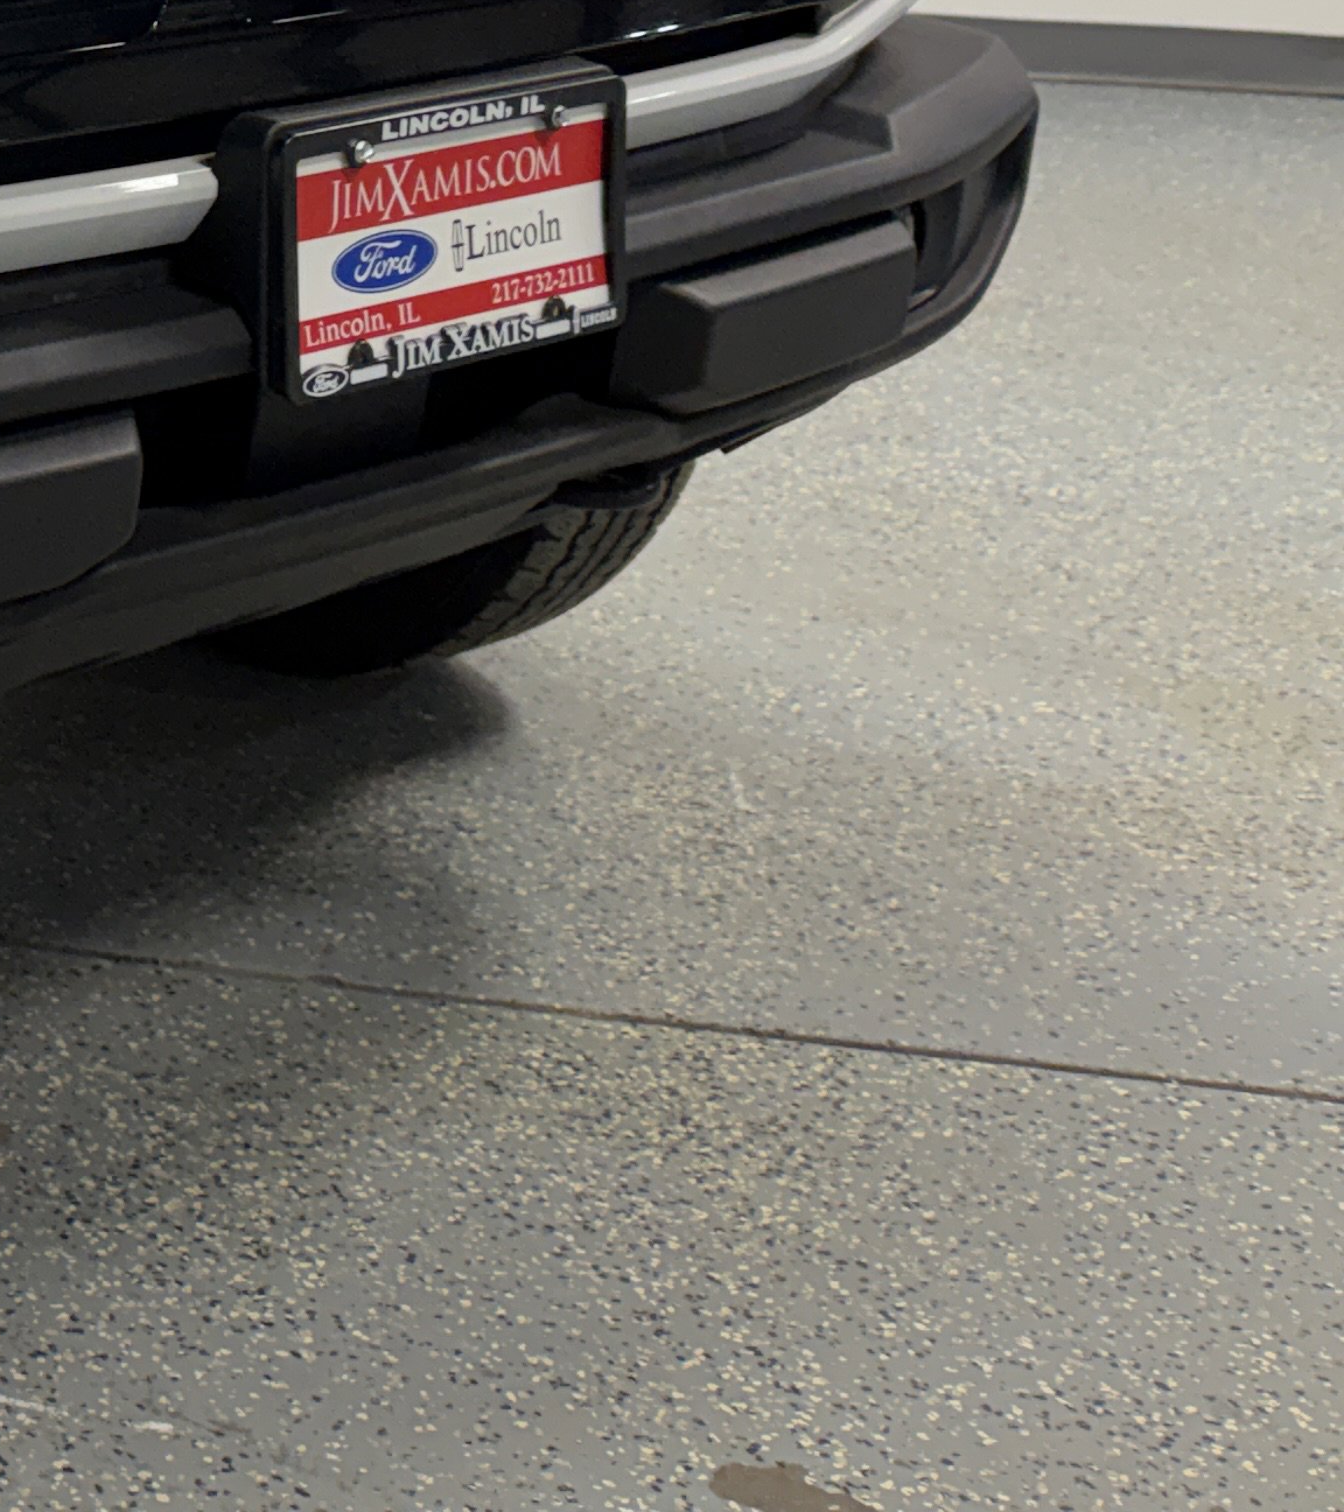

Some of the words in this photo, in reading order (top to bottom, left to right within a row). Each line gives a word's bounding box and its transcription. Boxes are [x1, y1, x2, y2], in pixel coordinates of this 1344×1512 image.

[381, 100, 513, 141] LINCOLN,
[520, 94, 546, 116] IL
[328, 141, 563, 234] JIMXAMIS.COM
[466, 209, 563, 261] Lincoln
[353, 239, 417, 284] Ford
[491, 262, 596, 305] 217-732-2111
[398, 302, 422, 326] IL
[392, 335, 444, 379] JIM
[448, 316, 537, 360] XAMIS
